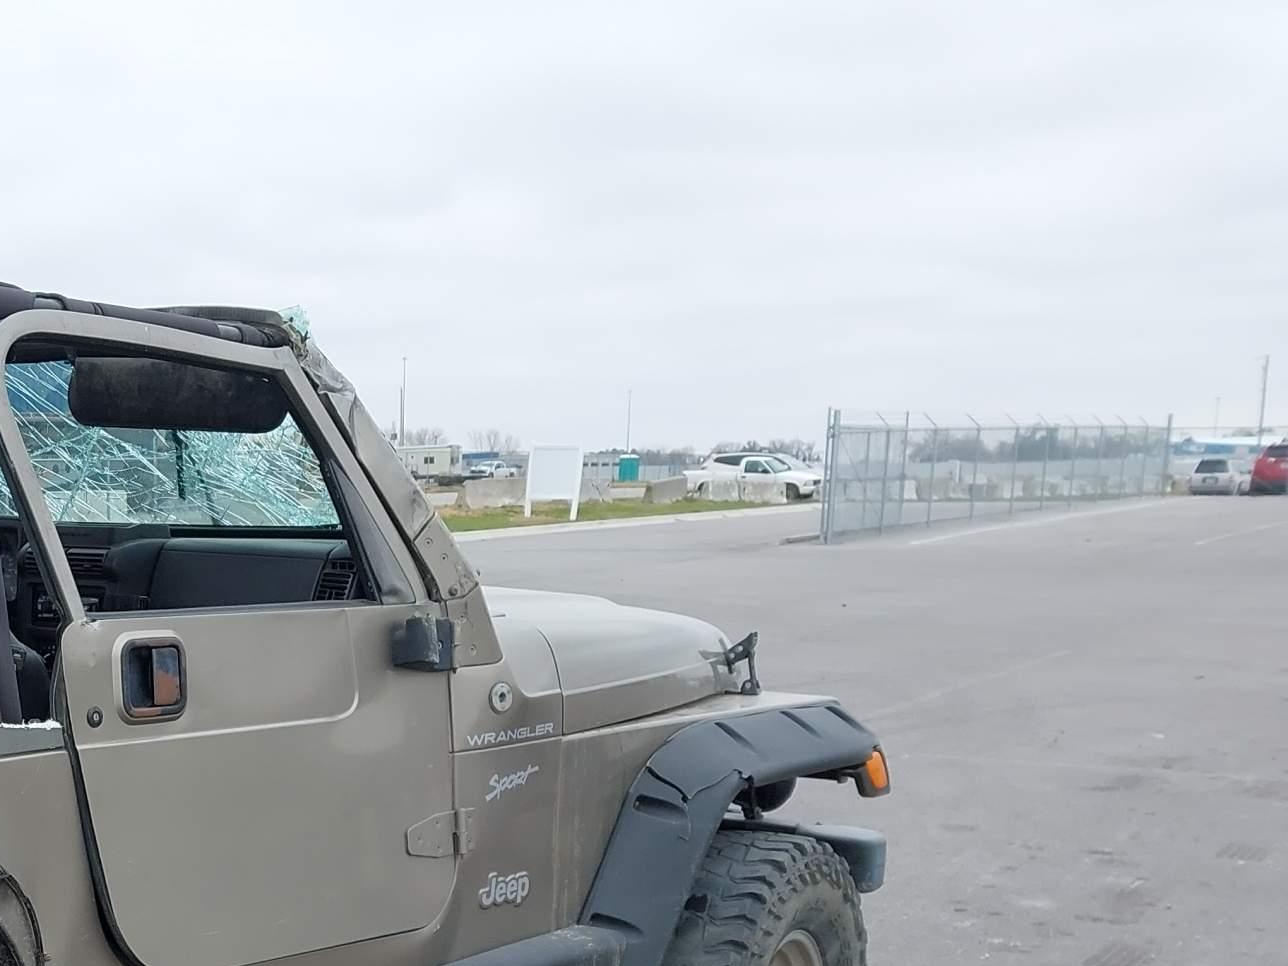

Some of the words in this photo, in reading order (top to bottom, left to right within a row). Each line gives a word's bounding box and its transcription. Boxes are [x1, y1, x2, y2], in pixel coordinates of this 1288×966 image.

[467, 722, 554, 746] WRANGLER
[485, 763, 539, 802] Sport
[478, 871, 530, 909] Jeep
